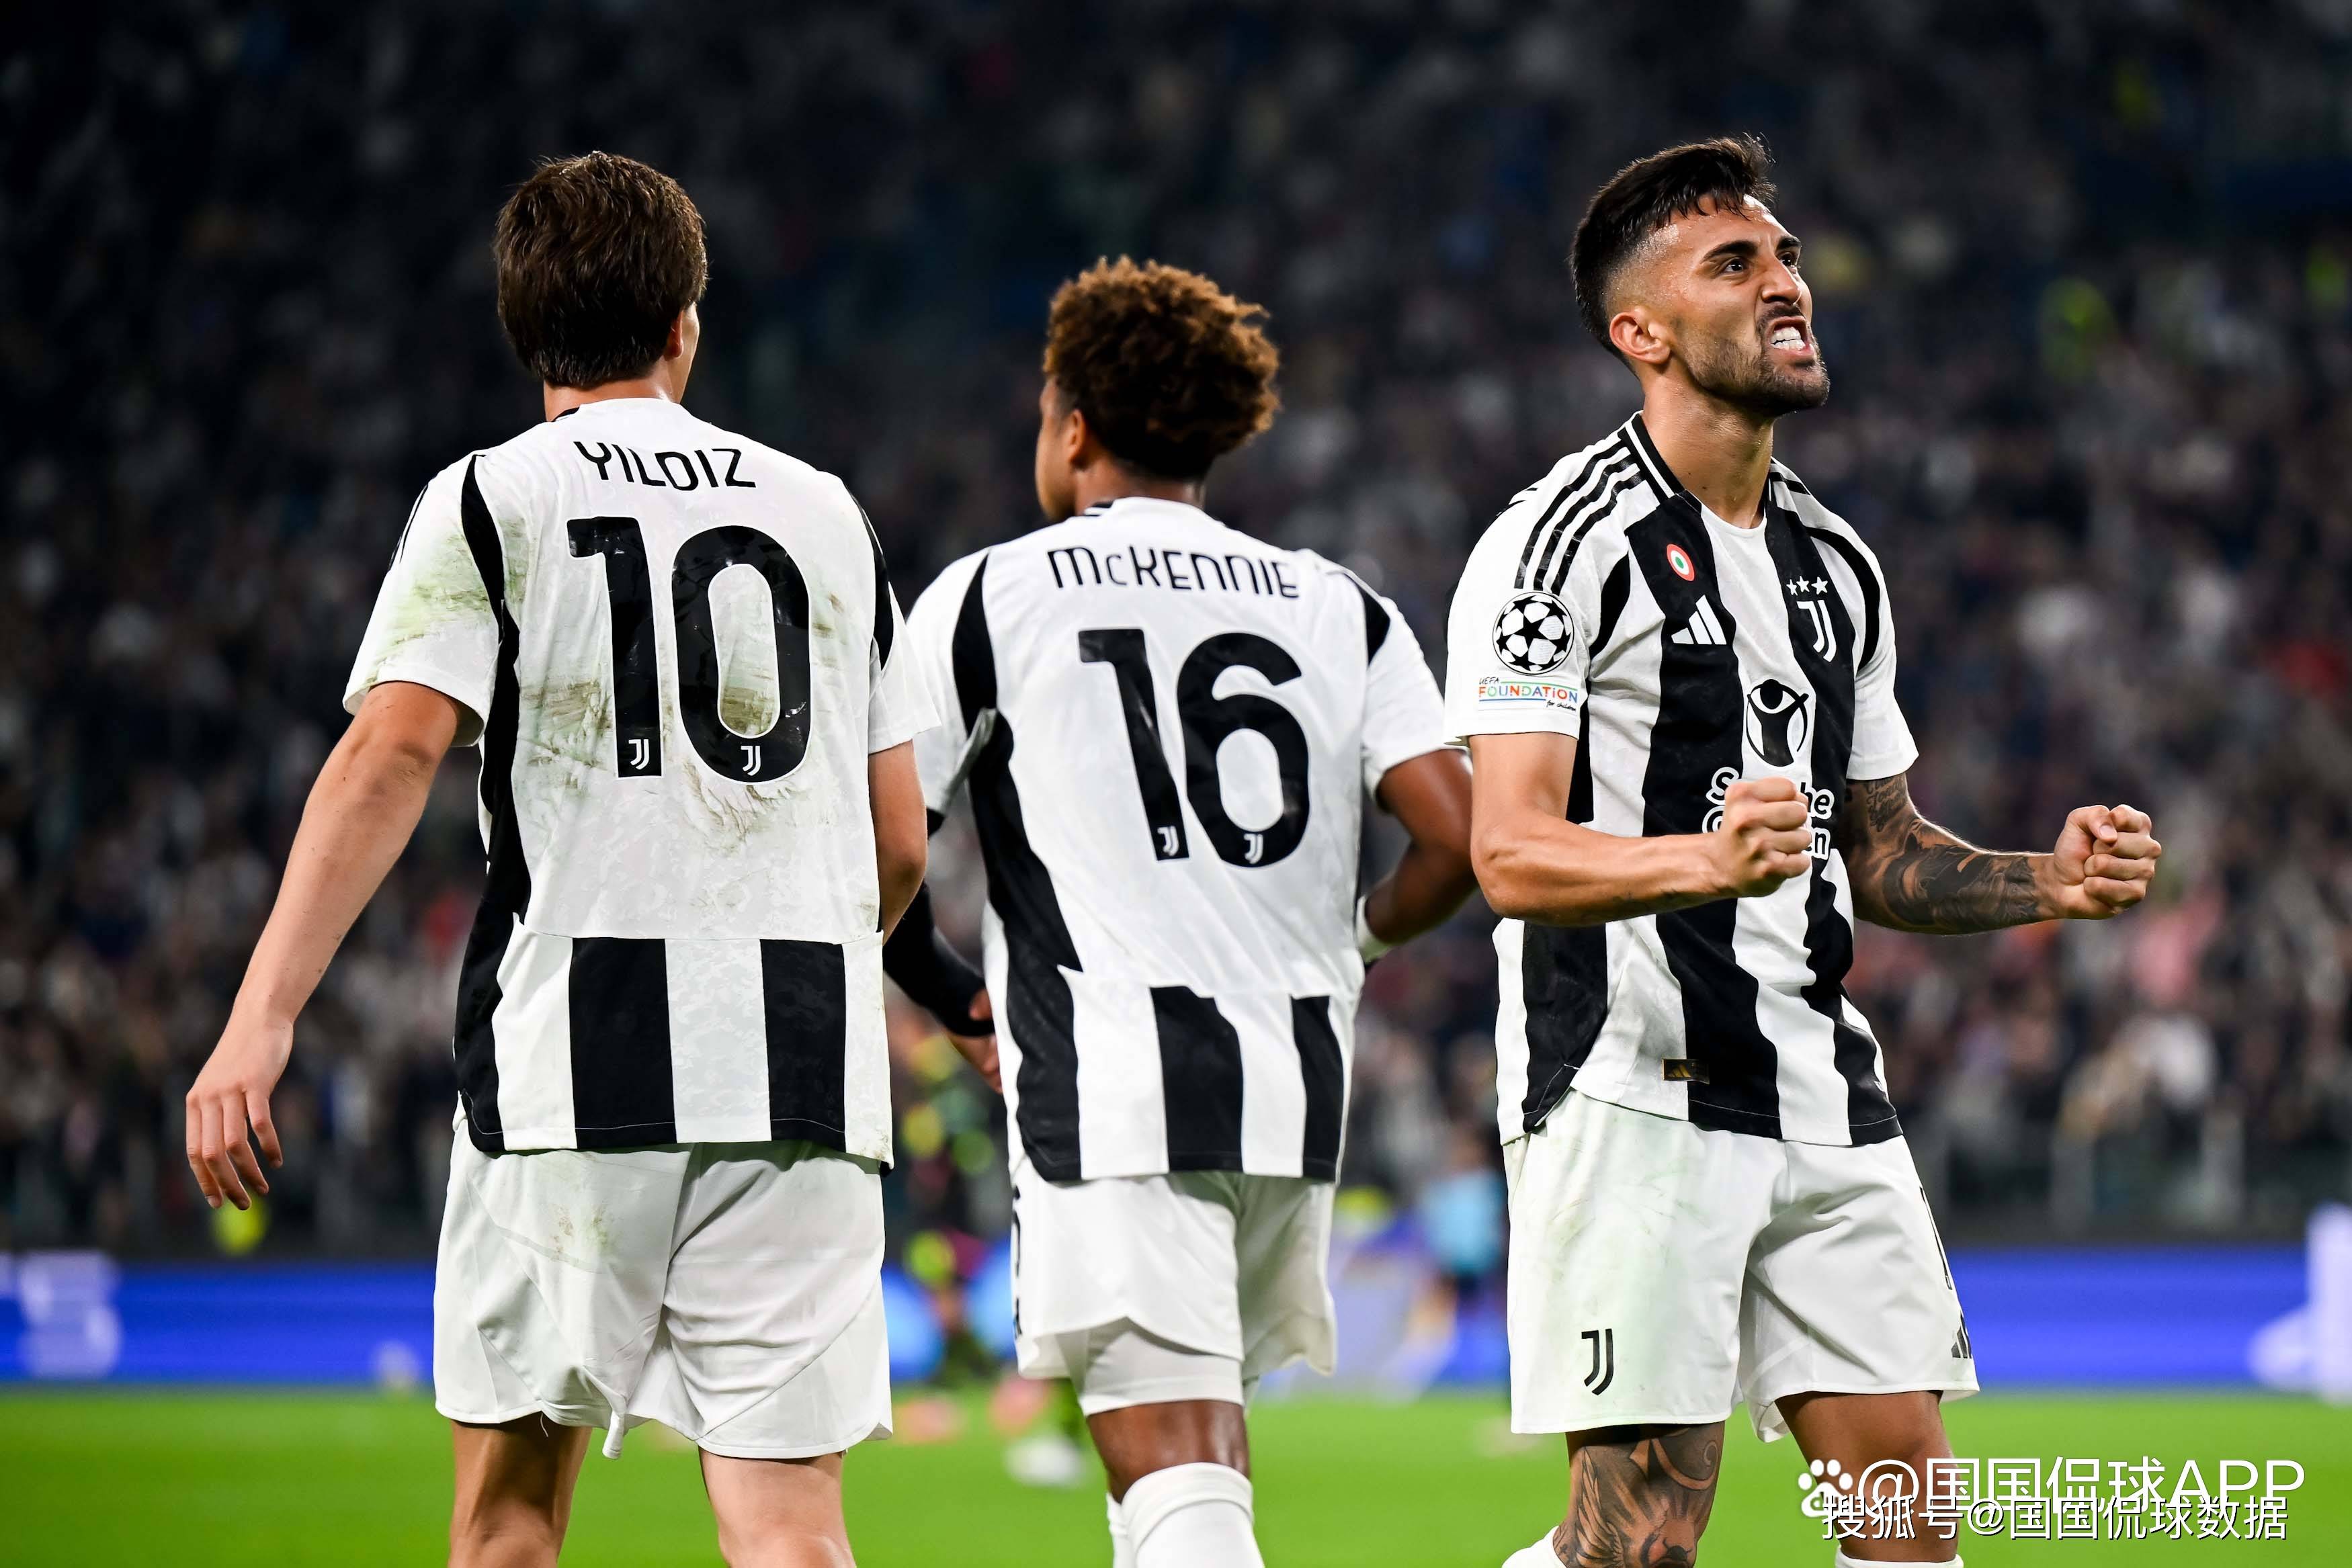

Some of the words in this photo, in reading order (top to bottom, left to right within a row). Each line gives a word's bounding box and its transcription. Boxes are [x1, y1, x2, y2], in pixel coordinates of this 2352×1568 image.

[573, 441, 756, 491] YILDIZ
[566, 516, 810, 784] 10
[1479, 677, 1500, 685] UEFA
[1078, 629, 1309, 867] 16
